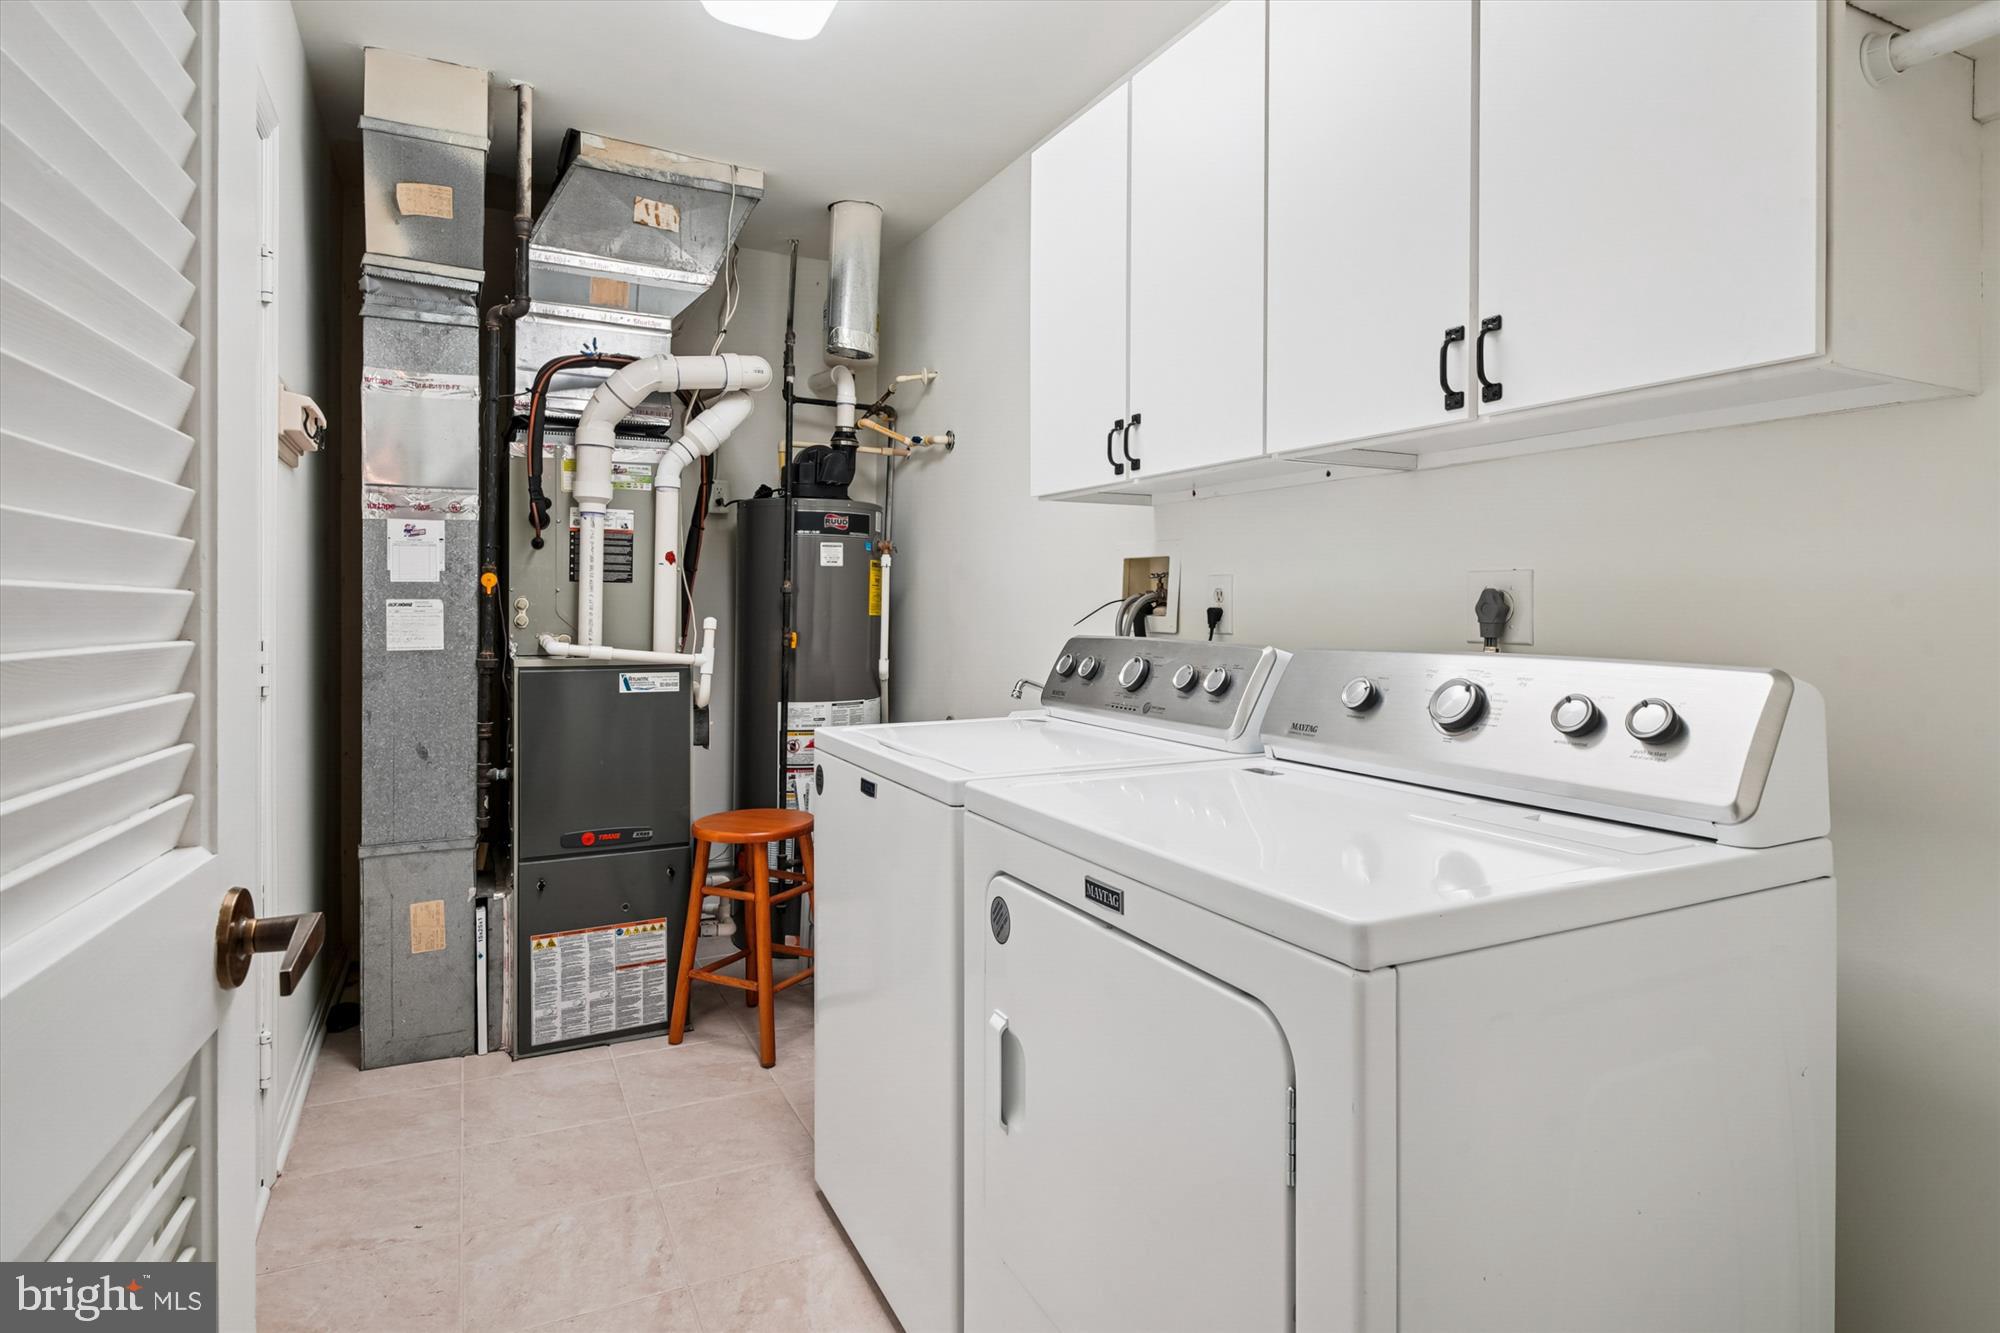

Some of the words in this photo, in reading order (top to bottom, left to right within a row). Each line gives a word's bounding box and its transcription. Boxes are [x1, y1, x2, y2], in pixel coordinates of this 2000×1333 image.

[825, 518, 848, 526] RUUD
[1291, 722, 1319, 733] MAYTAG
[1086, 883, 1119, 908] MAYTAG
